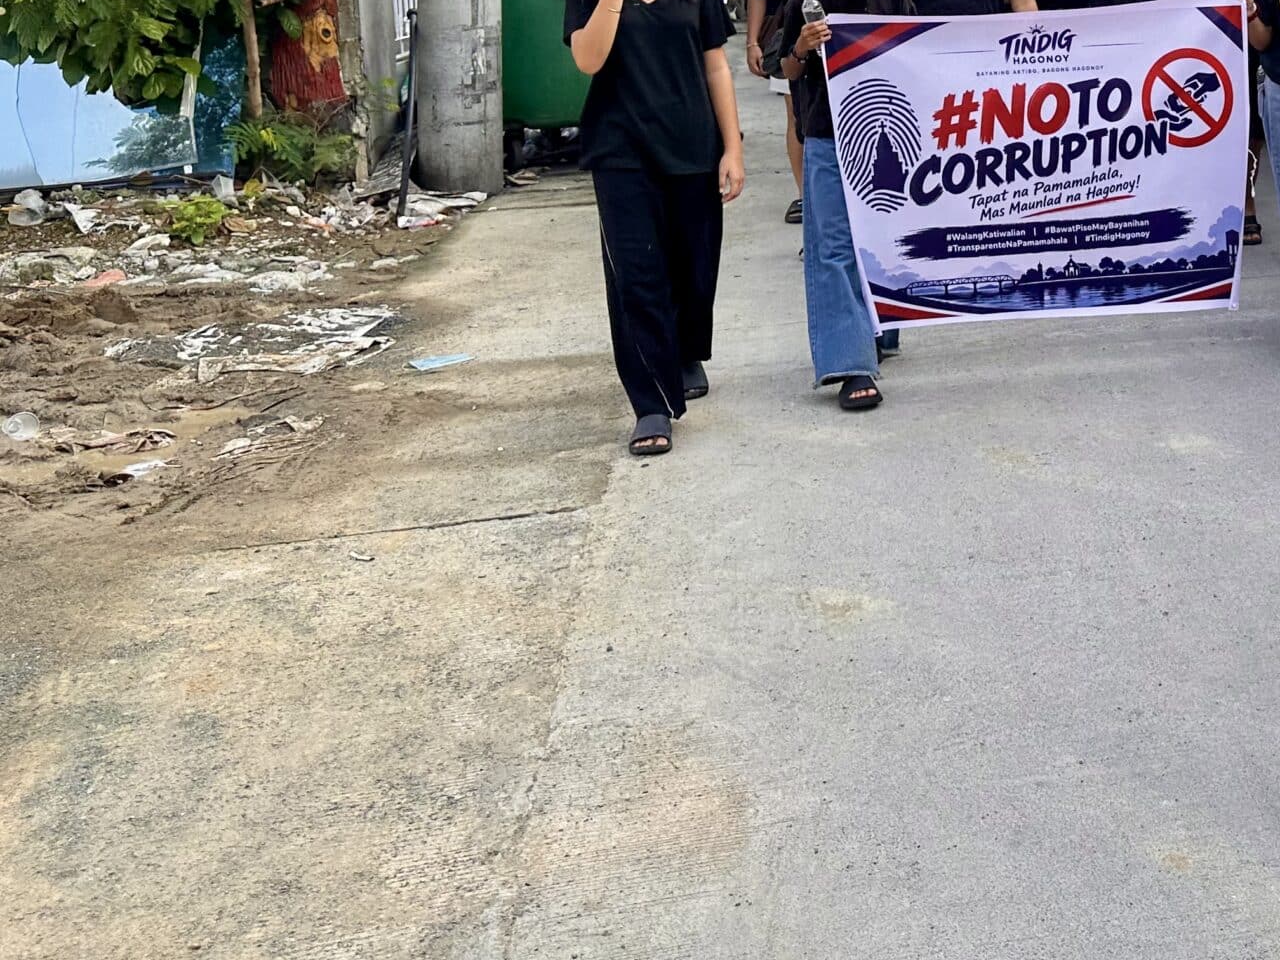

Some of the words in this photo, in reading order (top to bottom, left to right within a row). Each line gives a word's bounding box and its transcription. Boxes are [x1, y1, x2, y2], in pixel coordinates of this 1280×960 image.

[998, 28, 1077, 63] TINDIG
[1013, 54, 1070, 65] HAGONOY
[909, 120, 1168, 207] CORRUPTION
[968, 190, 1009, 210] Tapat
[1013, 187, 1029, 199] na
[1033, 167, 1124, 196] Pamamahala,
[980, 206, 1005, 222] Mas
[1008, 193, 1062, 218] Maunlad
[1065, 192, 1082, 205] na
[1086, 174, 1142, 201] Hagonoy!
[1085, 230, 1151, 242] #TindigHagonoy
